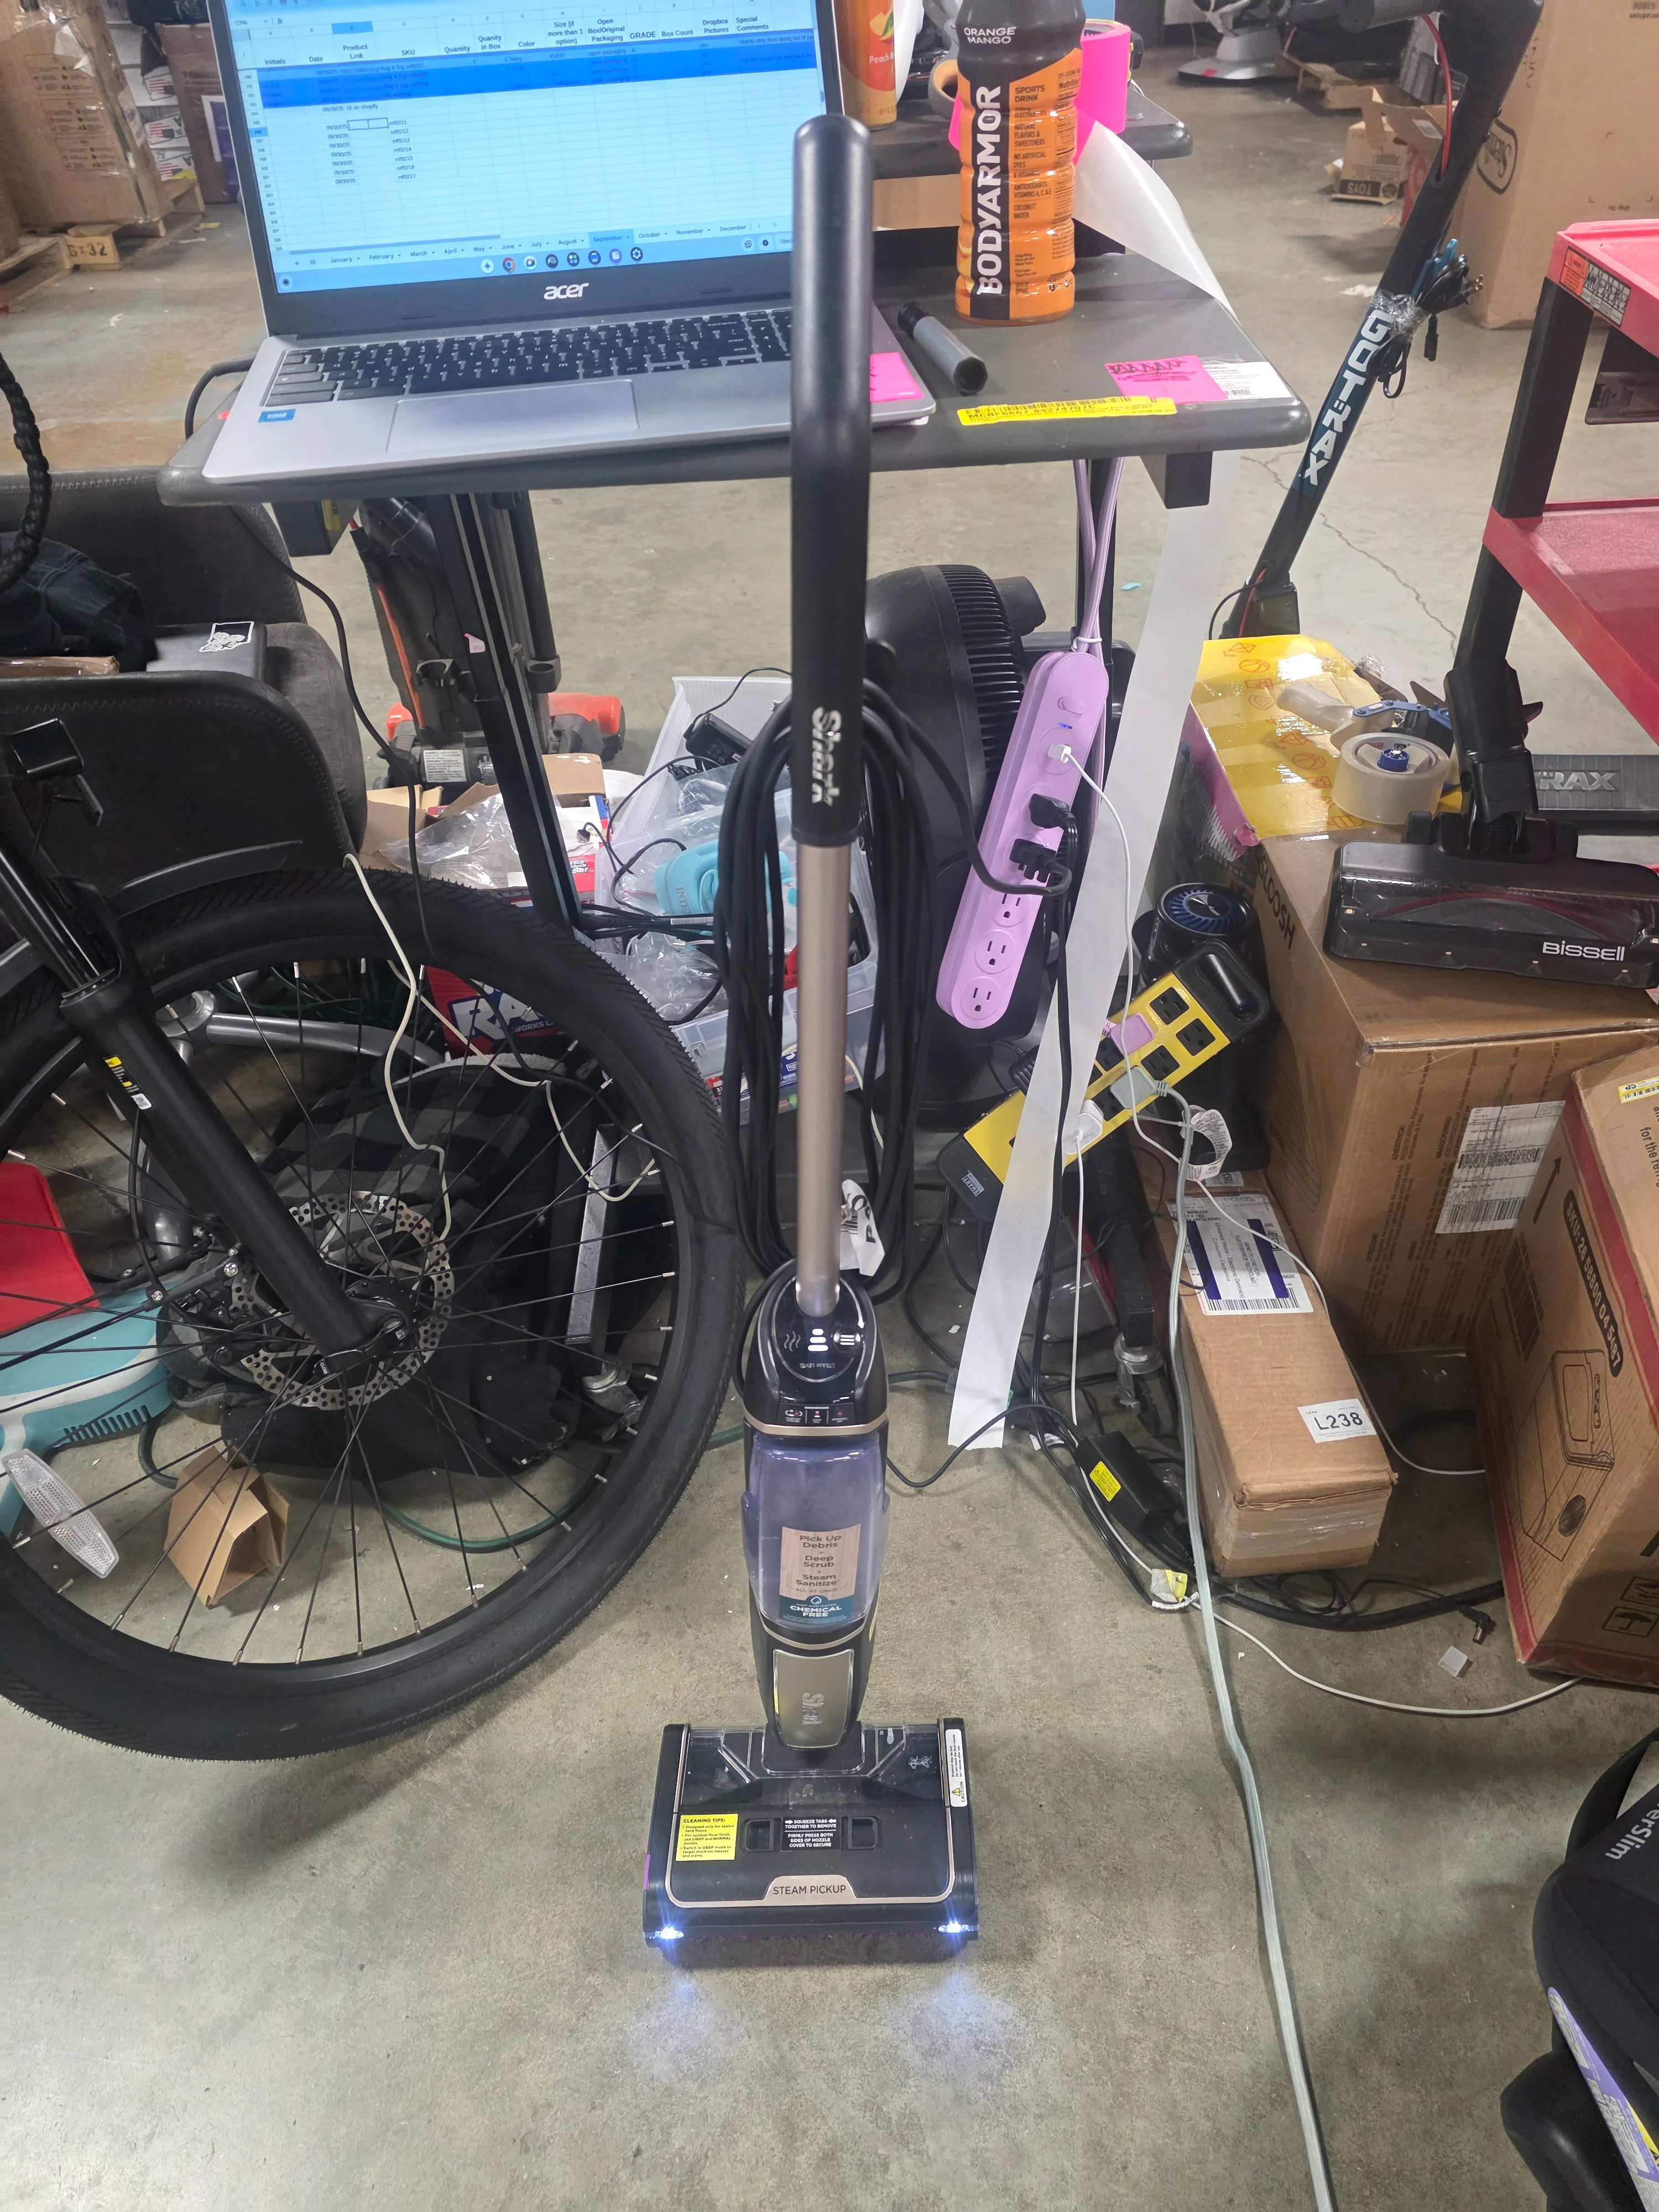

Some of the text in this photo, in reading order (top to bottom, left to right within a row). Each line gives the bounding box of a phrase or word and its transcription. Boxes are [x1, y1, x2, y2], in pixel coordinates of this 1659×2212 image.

[588, 25, 625, 34] Box/Original
[964, 27, 1017, 36] ORANGE
[555, 38, 577, 46] option)
[967, 36, 1011, 44] MANGO
[869, 54, 889, 64] Peach
[1015, 85, 1045, 94] SPORTS
[1014, 139, 1045, 147] SWEETENERS
[1022, 152, 1046, 160] ARTIFICIAL
[975, 86, 1002, 295] BODYARMOR
[1347, 182, 1371, 195] TOYS
[544, 283, 589, 300] acer
[1303, 309, 1393, 486] GOTRAX
[812, 706, 842, 807] Shark
[1259, 853, 1296, 951] SLOOSH
[451, 990, 543, 1042] RA
[513, 1021, 545, 1033] WORKS
[1391, 1125, 1406, 1160] ADVERTENCIA!
[1436, 1115, 1452, 1159] WAARSCHUWING!
[1639, 1126, 1652, 1141] for
[1645, 1141, 1657, 1159] the
[964, 1176, 979, 1194] SMART
[1214, 1222, 1225, 1241] Universal
[1227, 1257, 1237, 1277] Electronic
[1212, 1238, 1232, 1282] Consumer Electronics
[1235, 1235, 1257, 1285] ELECTRONICS RECYCLING
[1566, 1201, 1580, 1241] SKU:
[1577, 1237, 1588, 1261] 26
[1584, 1258, 1602, 1307] 58800
[1599, 1303, 1613, 1330] 04
[1314, 1412, 1363, 1430] L238
[1605, 1802, 1659, 1860] erSlim
[773, 1885, 846, 1895] STEAM PICKUP
